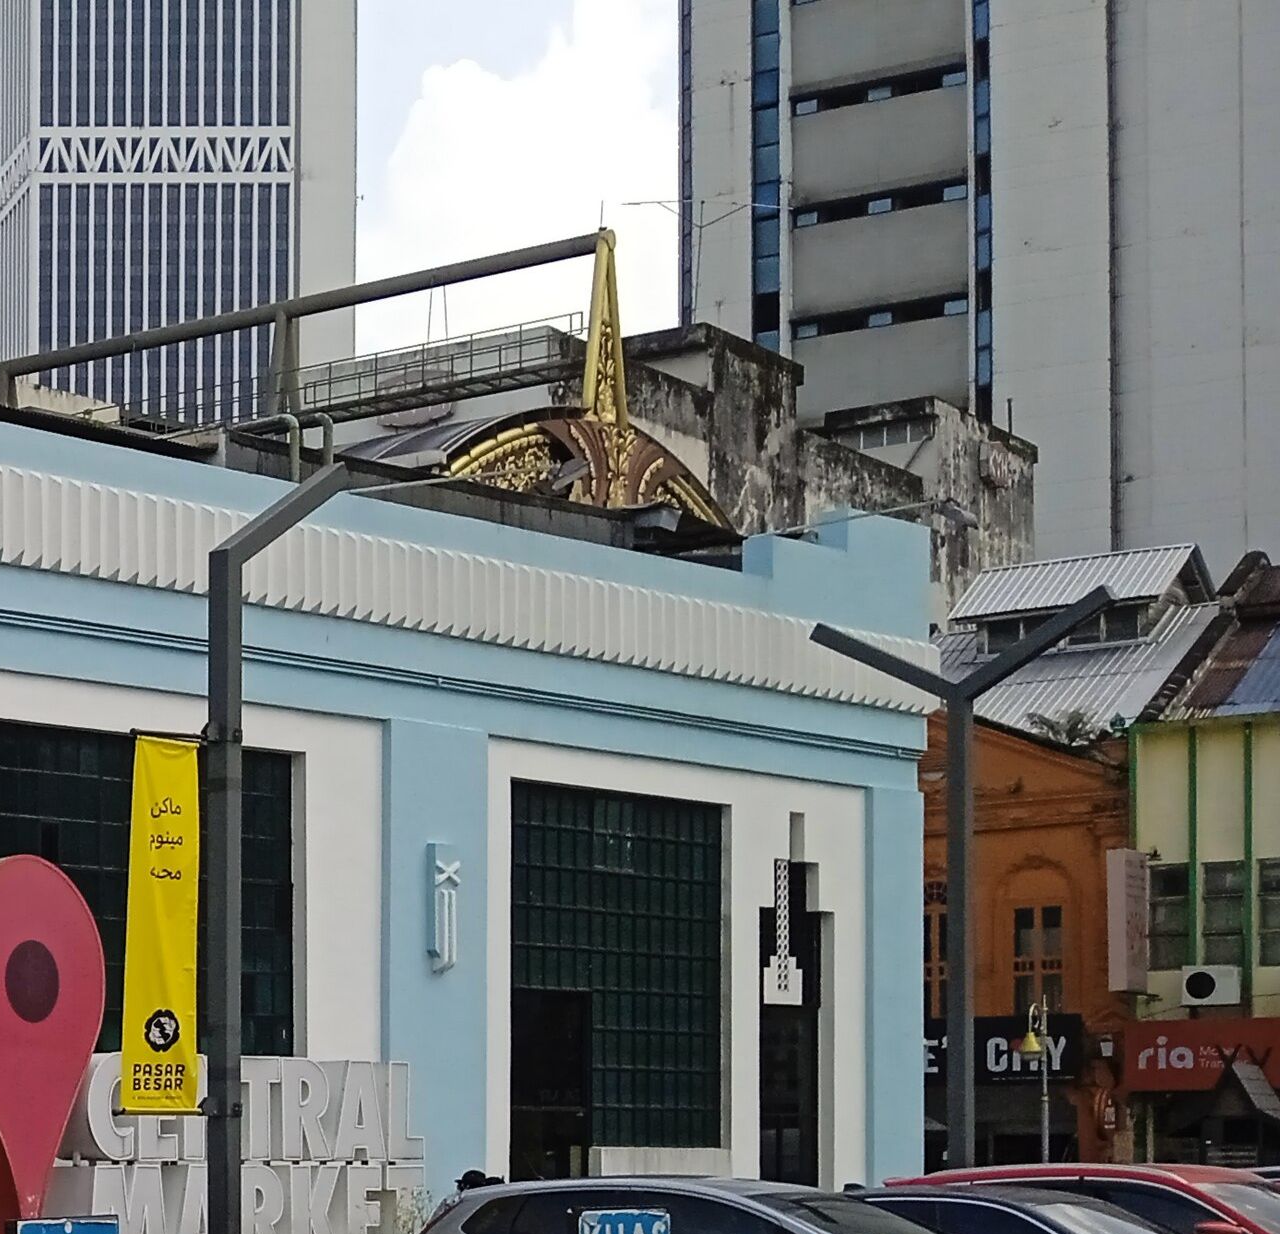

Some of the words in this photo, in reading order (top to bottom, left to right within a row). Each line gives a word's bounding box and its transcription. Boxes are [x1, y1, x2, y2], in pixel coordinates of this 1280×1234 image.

[1137, 1035, 1194, 1070] ria
[133, 1063, 186, 1077] PASAR
[132, 1077, 184, 1091] BESAR
